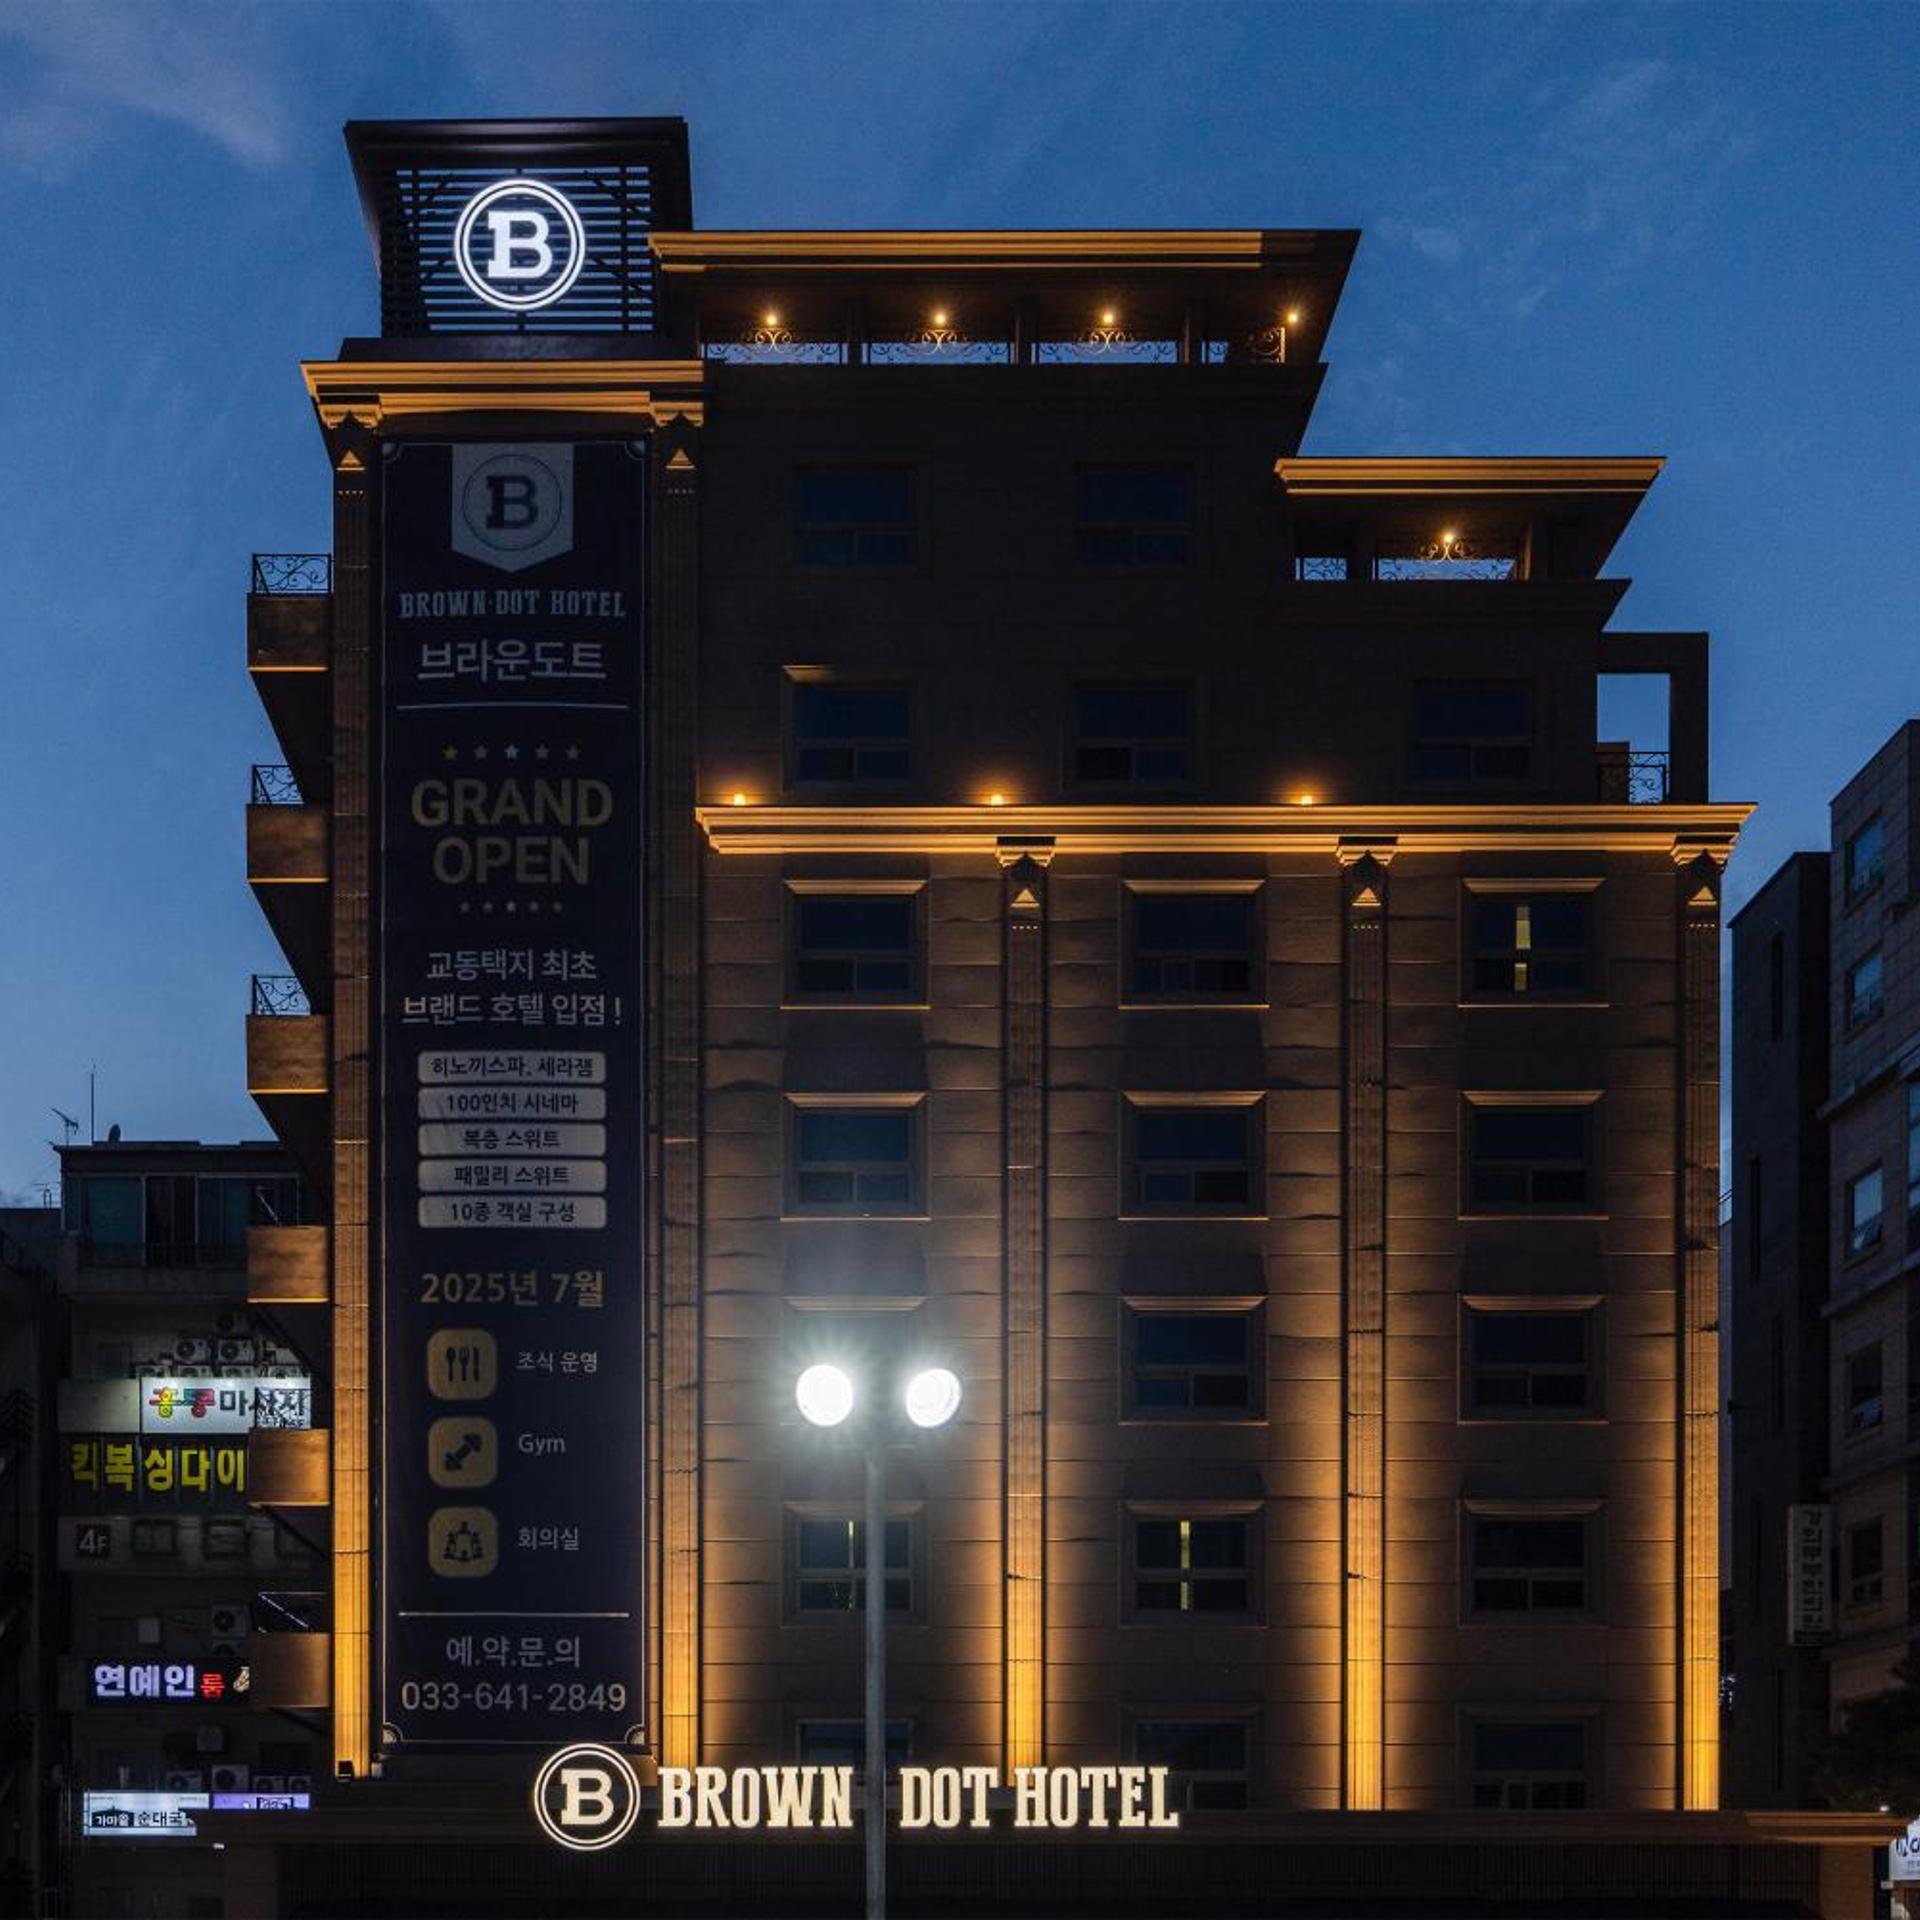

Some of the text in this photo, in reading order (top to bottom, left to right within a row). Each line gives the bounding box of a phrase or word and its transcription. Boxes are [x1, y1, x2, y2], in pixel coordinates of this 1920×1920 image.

[551, 591, 626, 617] HOTEL
[417, 638, 607, 683] 브라운도트
[411, 777, 613, 828] GRAND
[433, 836, 591, 884] OPEN
[427, 949, 597, 981] 교동택지 최초
[402, 994, 485, 1026] 브랜드
[490, 993, 545, 1026] 호텔
[447, 1092, 578, 1114] 100인치 시네마
[464, 1129, 561, 1150] 복층 스위트
[454, 1165, 570, 1186] 패밀리 스위트
[452, 1202, 576, 1223] 10종 객실 구성
[420, 1270, 604, 1308] 2025년 7월
[516, 1351, 598, 1374] 조식 운영
[517, 1433, 566, 1457] Gym
[78, 1527, 108, 1554] 4F
[517, 1527, 580, 1551] 회의실
[401, 1681, 627, 1713] 033-641-2849
[657, 1766, 854, 1828] BROWN
[900, 1767, 998, 1828] DOT
[1014, 1767, 1179, 1828] HOTEL
